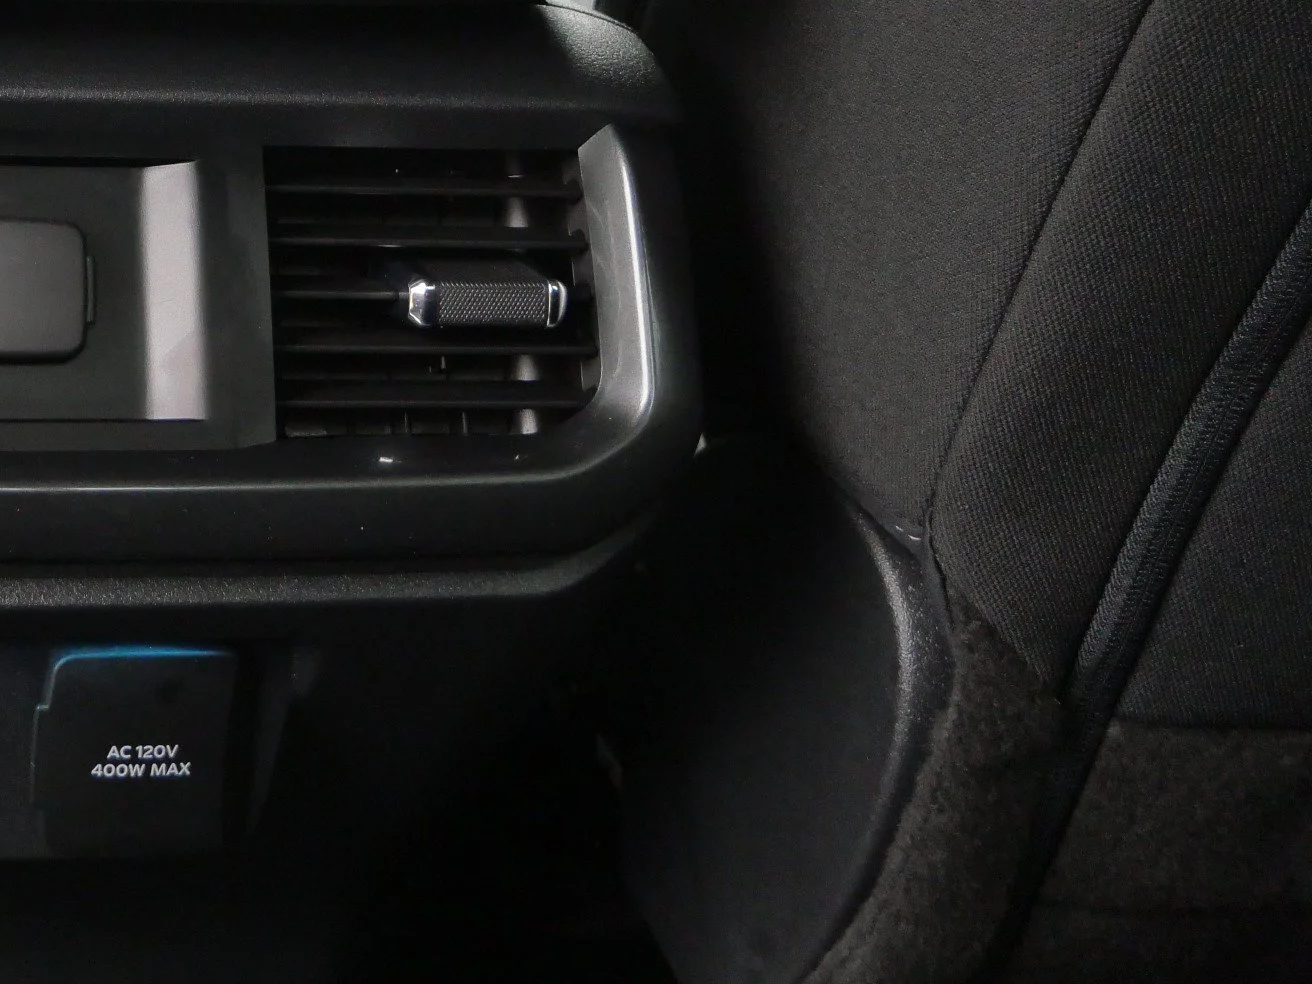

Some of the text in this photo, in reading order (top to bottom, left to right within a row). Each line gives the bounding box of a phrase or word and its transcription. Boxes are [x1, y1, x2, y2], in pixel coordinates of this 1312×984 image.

[106, 744, 179, 759] AC 120V
[90, 761, 191, 777] 400W MAX
